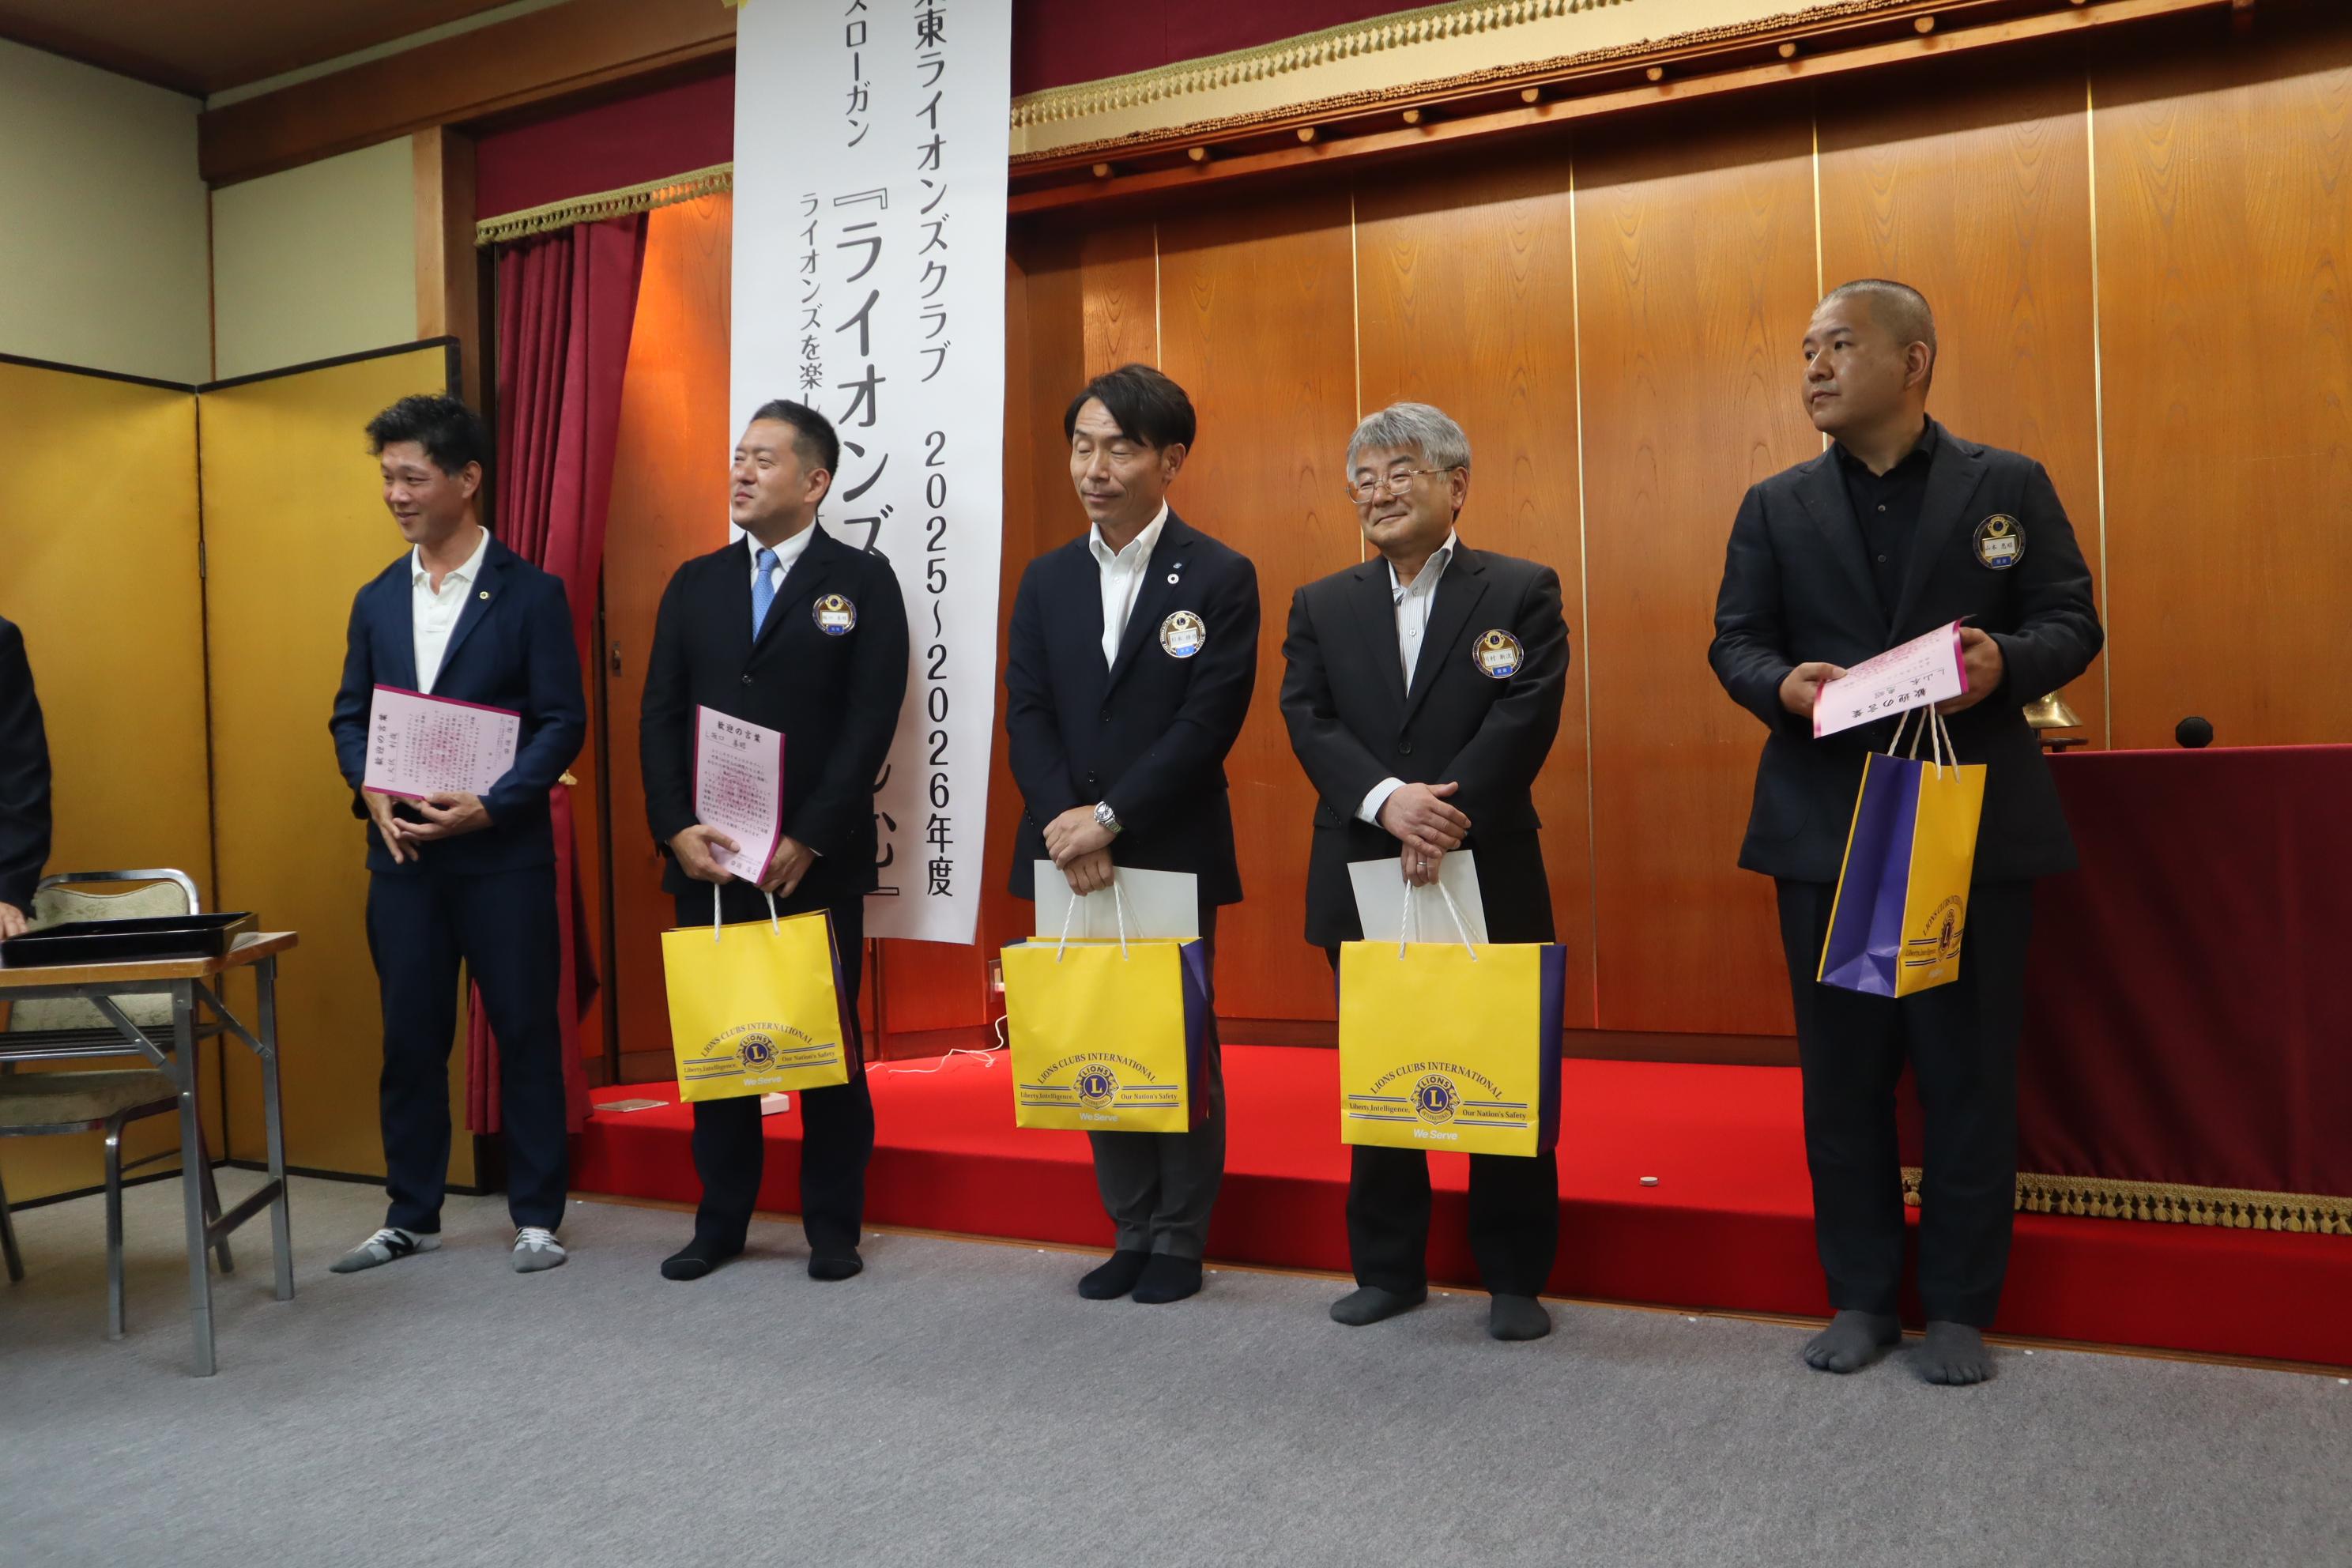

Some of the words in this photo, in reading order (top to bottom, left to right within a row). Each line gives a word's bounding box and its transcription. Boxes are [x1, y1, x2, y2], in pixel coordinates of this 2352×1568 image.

[1852, 687, 1927, 718] 歓迎の言葉
[701, 1036, 721, 1057] LIONS
[721, 1024, 746, 1040] CLUBS
[747, 1021, 814, 1045] INTERNATIONAL
[744, 1034, 769, 1046] LIONS
[752, 1046, 764, 1060] L
[818, 1050, 835, 1059] Safety
[1037, 1063, 1058, 1084] LIONS
[1058, 1054, 1086, 1069] CLUBS
[1087, 1052, 1157, 1084] INTERNATIONAL
[1082, 1065, 1109, 1076] LIONS
[743, 1077, 757, 1086] We
[758, 1076, 782, 1085] Serve
[1091, 1078, 1103, 1094] L
[1370, 1072, 1396, 1095] LIONS
[1396, 1062, 1426, 1076] CLUBS
[1427, 1061, 1503, 1100] INTERNATIONAL
[1421, 1076, 1449, 1087] LIONS
[1159, 1092, 1178, 1101] Safety
[1430, 1089, 1443, 1107] L
[1080, 1112, 1093, 1121] We
[1094, 1113, 1119, 1122] Serve
[1476, 1110, 1504, 1118] Nation's
[1505, 1110, 1527, 1120] Safety
[1414, 1128, 1429, 1138] We
[1430, 1129, 1459, 1140] Serve
